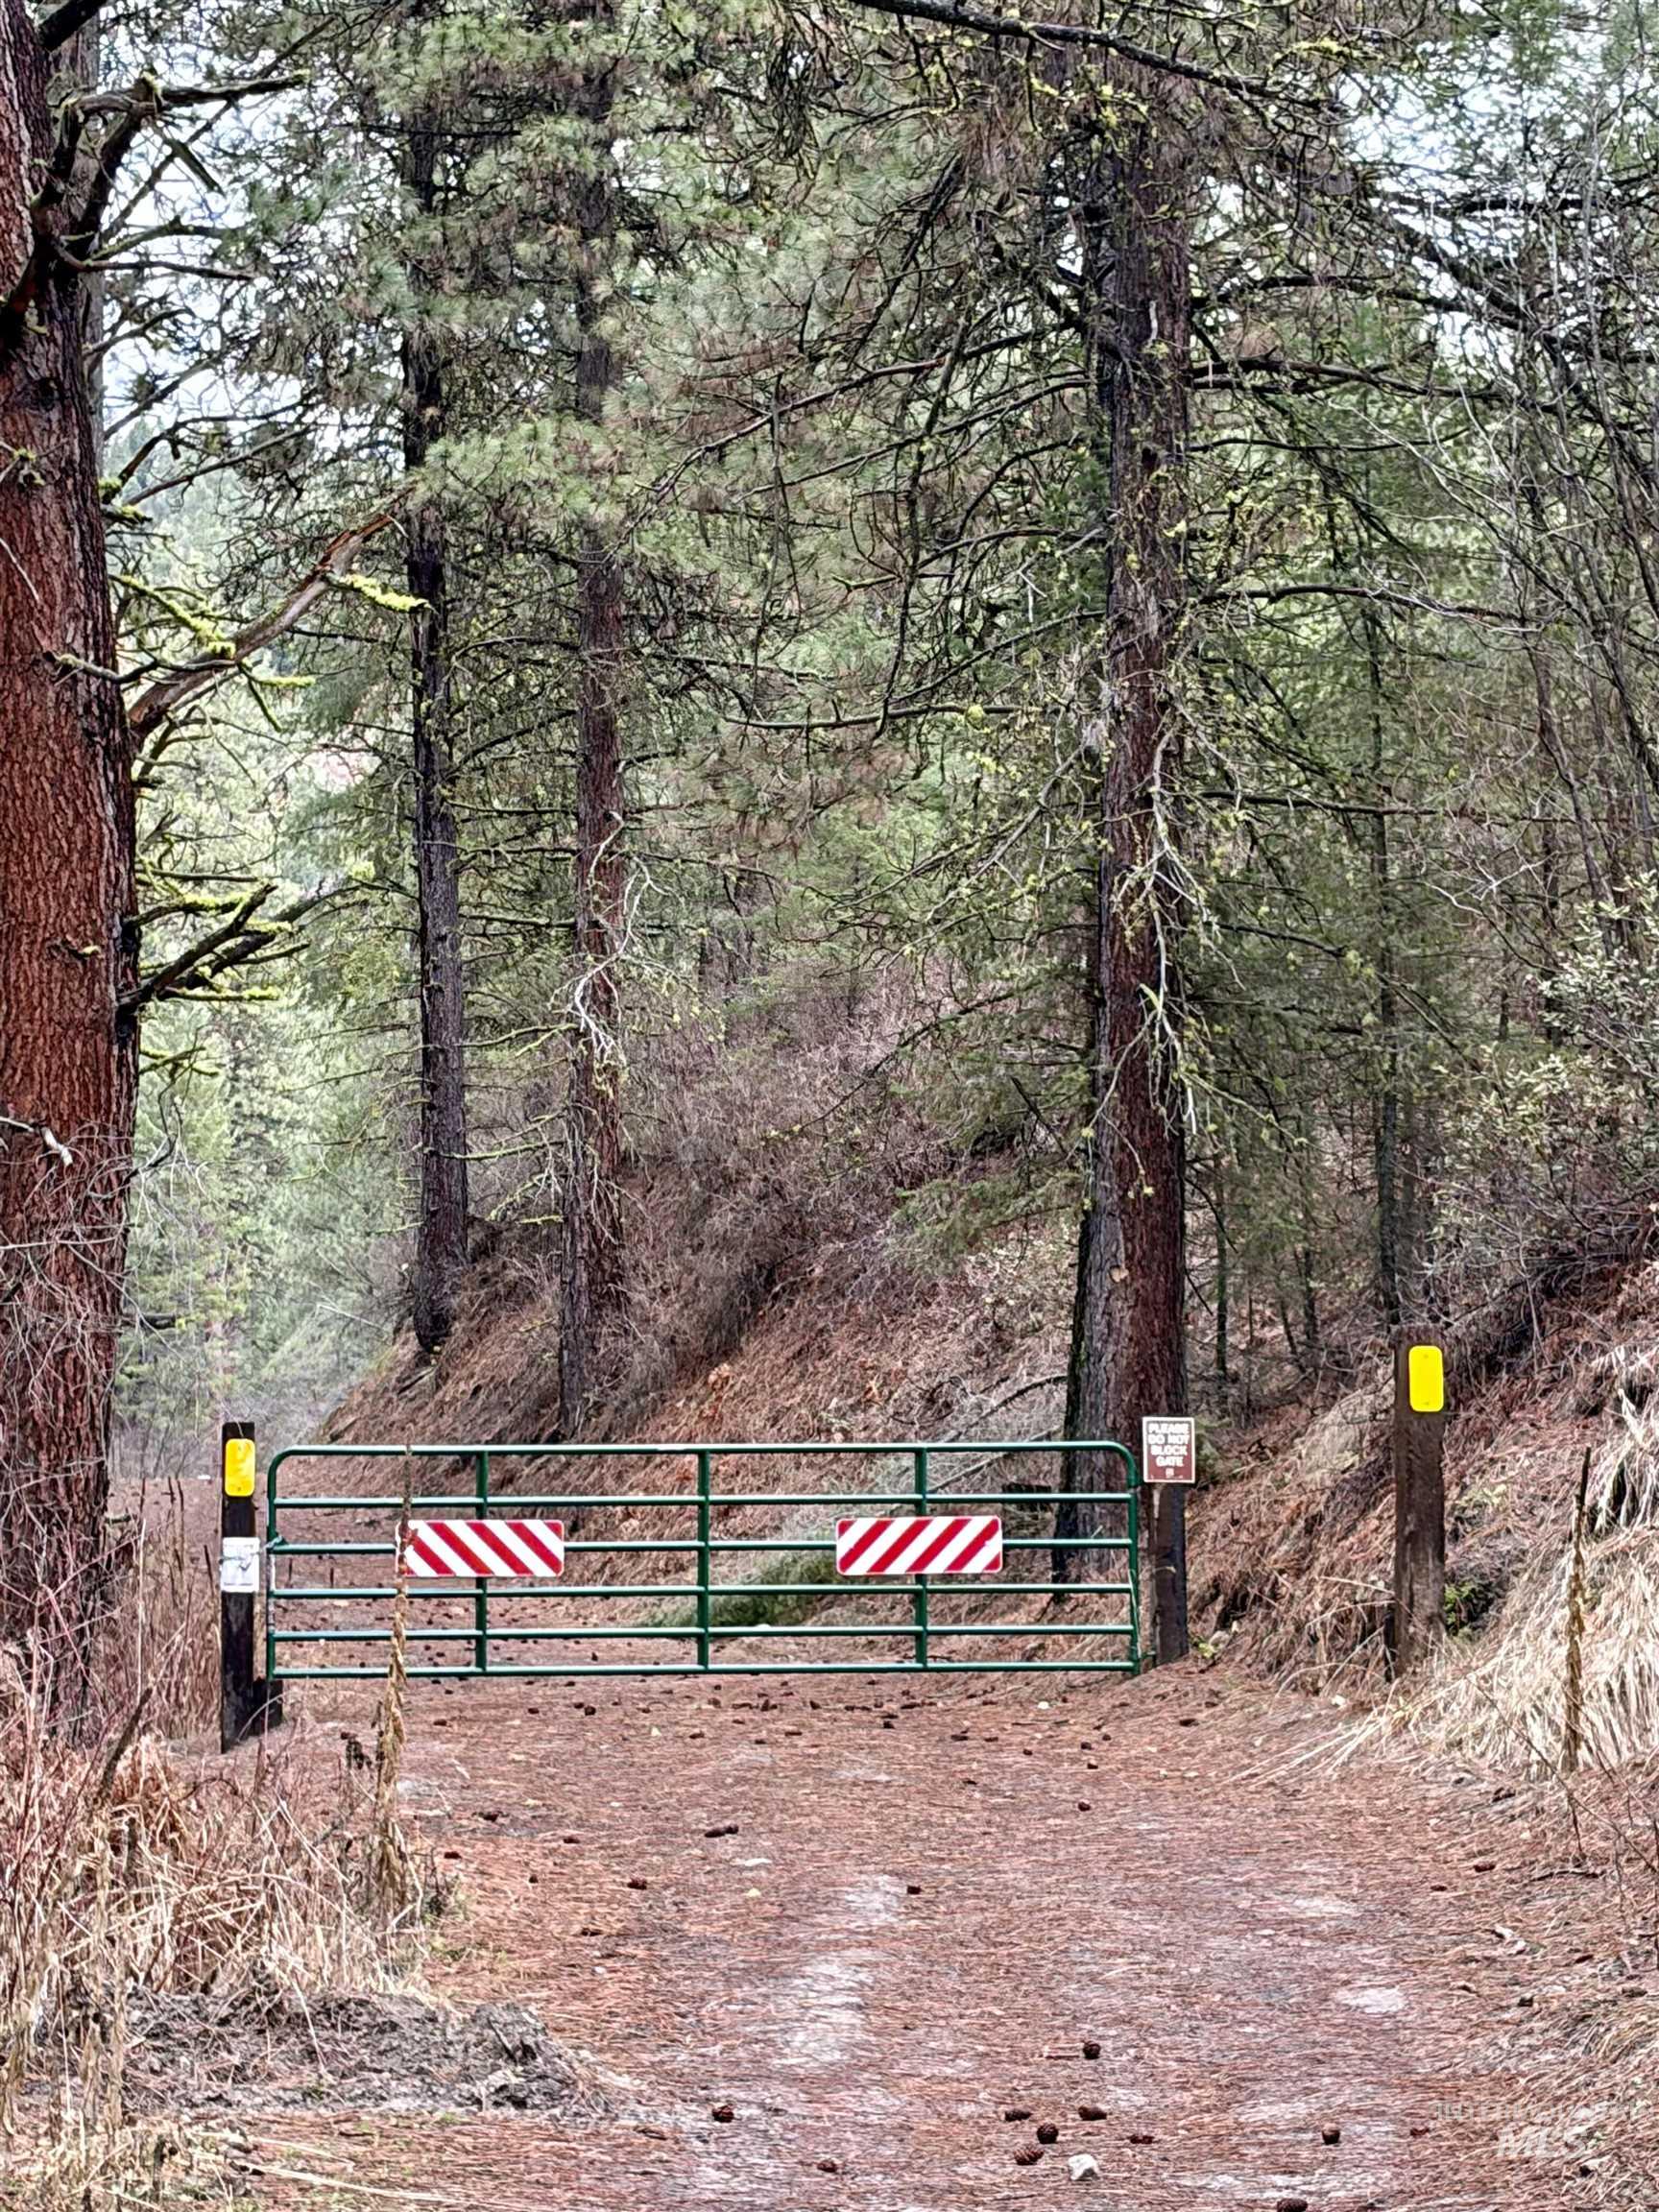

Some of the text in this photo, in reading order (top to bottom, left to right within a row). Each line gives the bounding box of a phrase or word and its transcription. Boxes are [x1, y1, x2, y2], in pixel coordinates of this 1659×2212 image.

[1148, 1423, 1190, 1434] PLEASE
[1147, 1434, 1190, 1445] DO NOT
[1150, 1445, 1189, 1456] BLOCK
[1155, 1455, 1185, 1467] GATE
